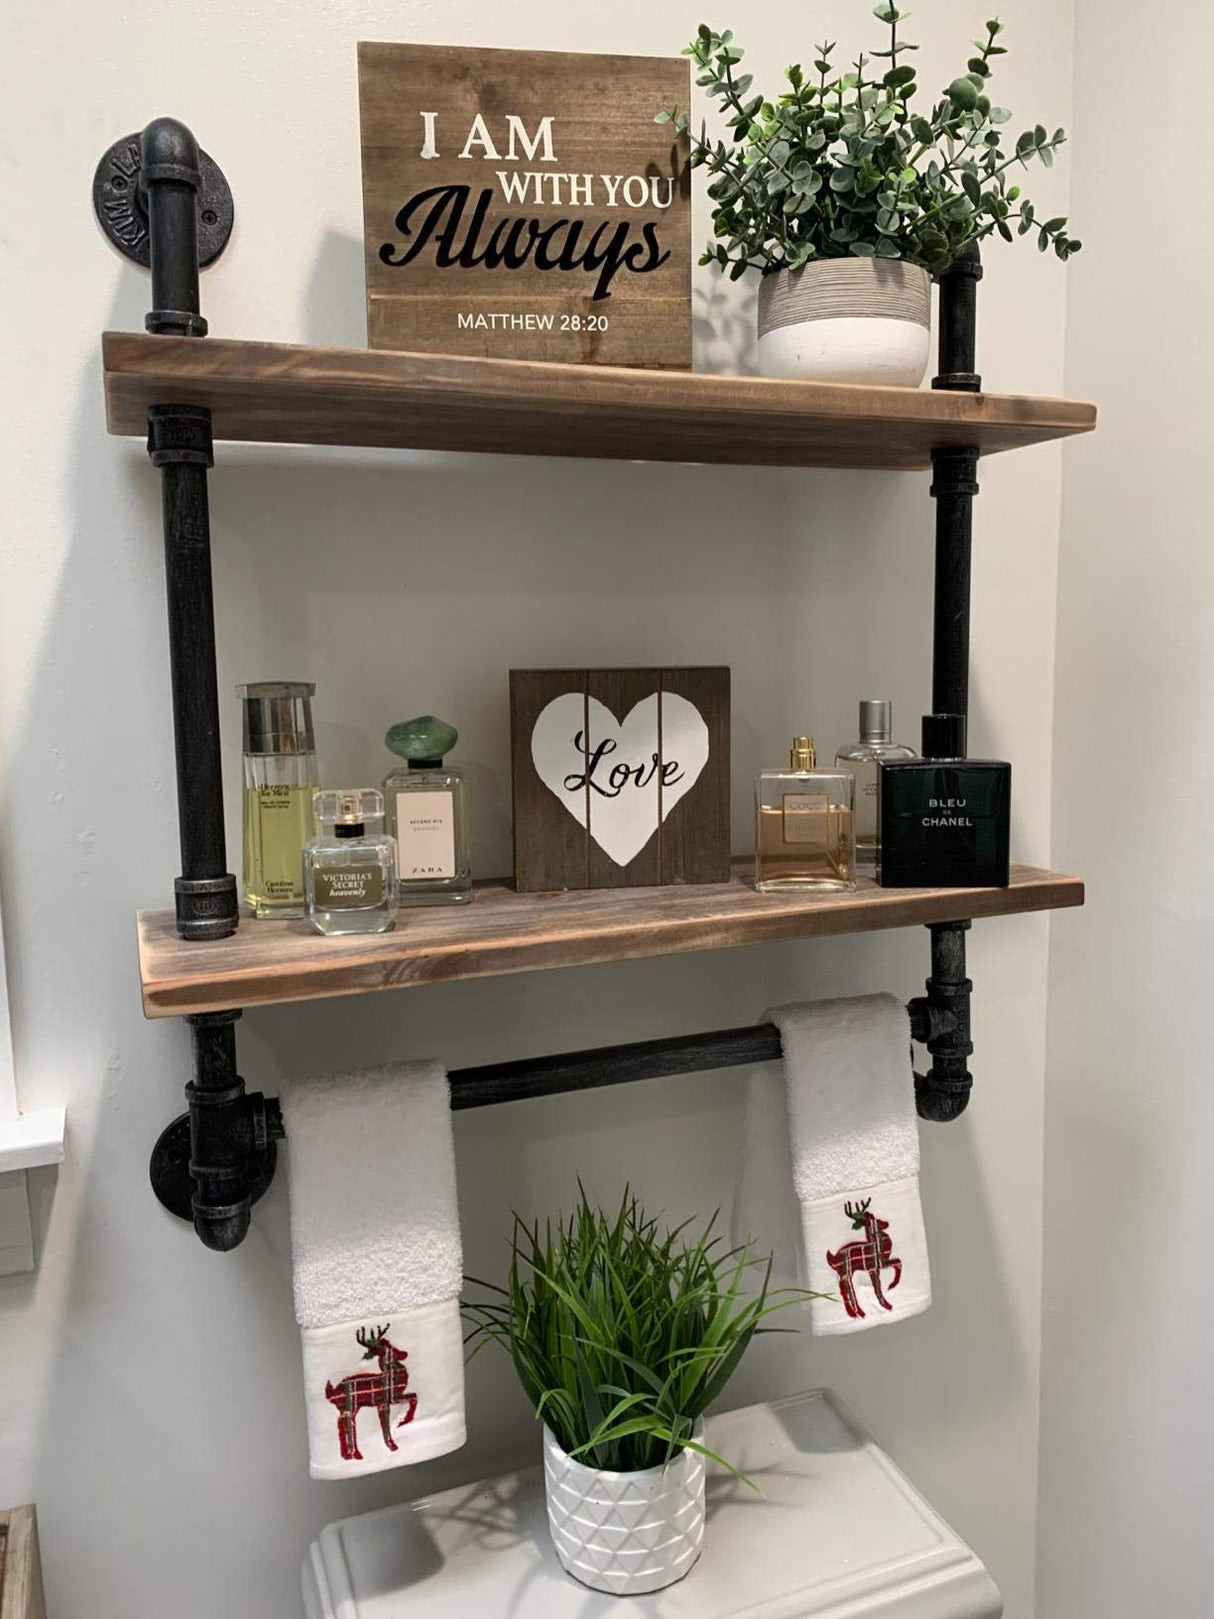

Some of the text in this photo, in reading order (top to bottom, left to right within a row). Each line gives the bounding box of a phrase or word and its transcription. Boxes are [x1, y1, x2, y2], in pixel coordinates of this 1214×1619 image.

[419, 111, 558, 162] I AM
[496, 170, 675, 209] WITH YOU
[379, 184, 671, 301] Always
[458, 313, 609, 332] MATTHEW 28:20
[564, 730, 686, 798] Love
[928, 798, 967, 808] BLEU
[921, 817, 973, 827] CHANEL
[322, 873, 373, 882] VICTORIA'S
[332, 881, 365, 889] SECRET
[329, 888, 367, 898] heavenly
